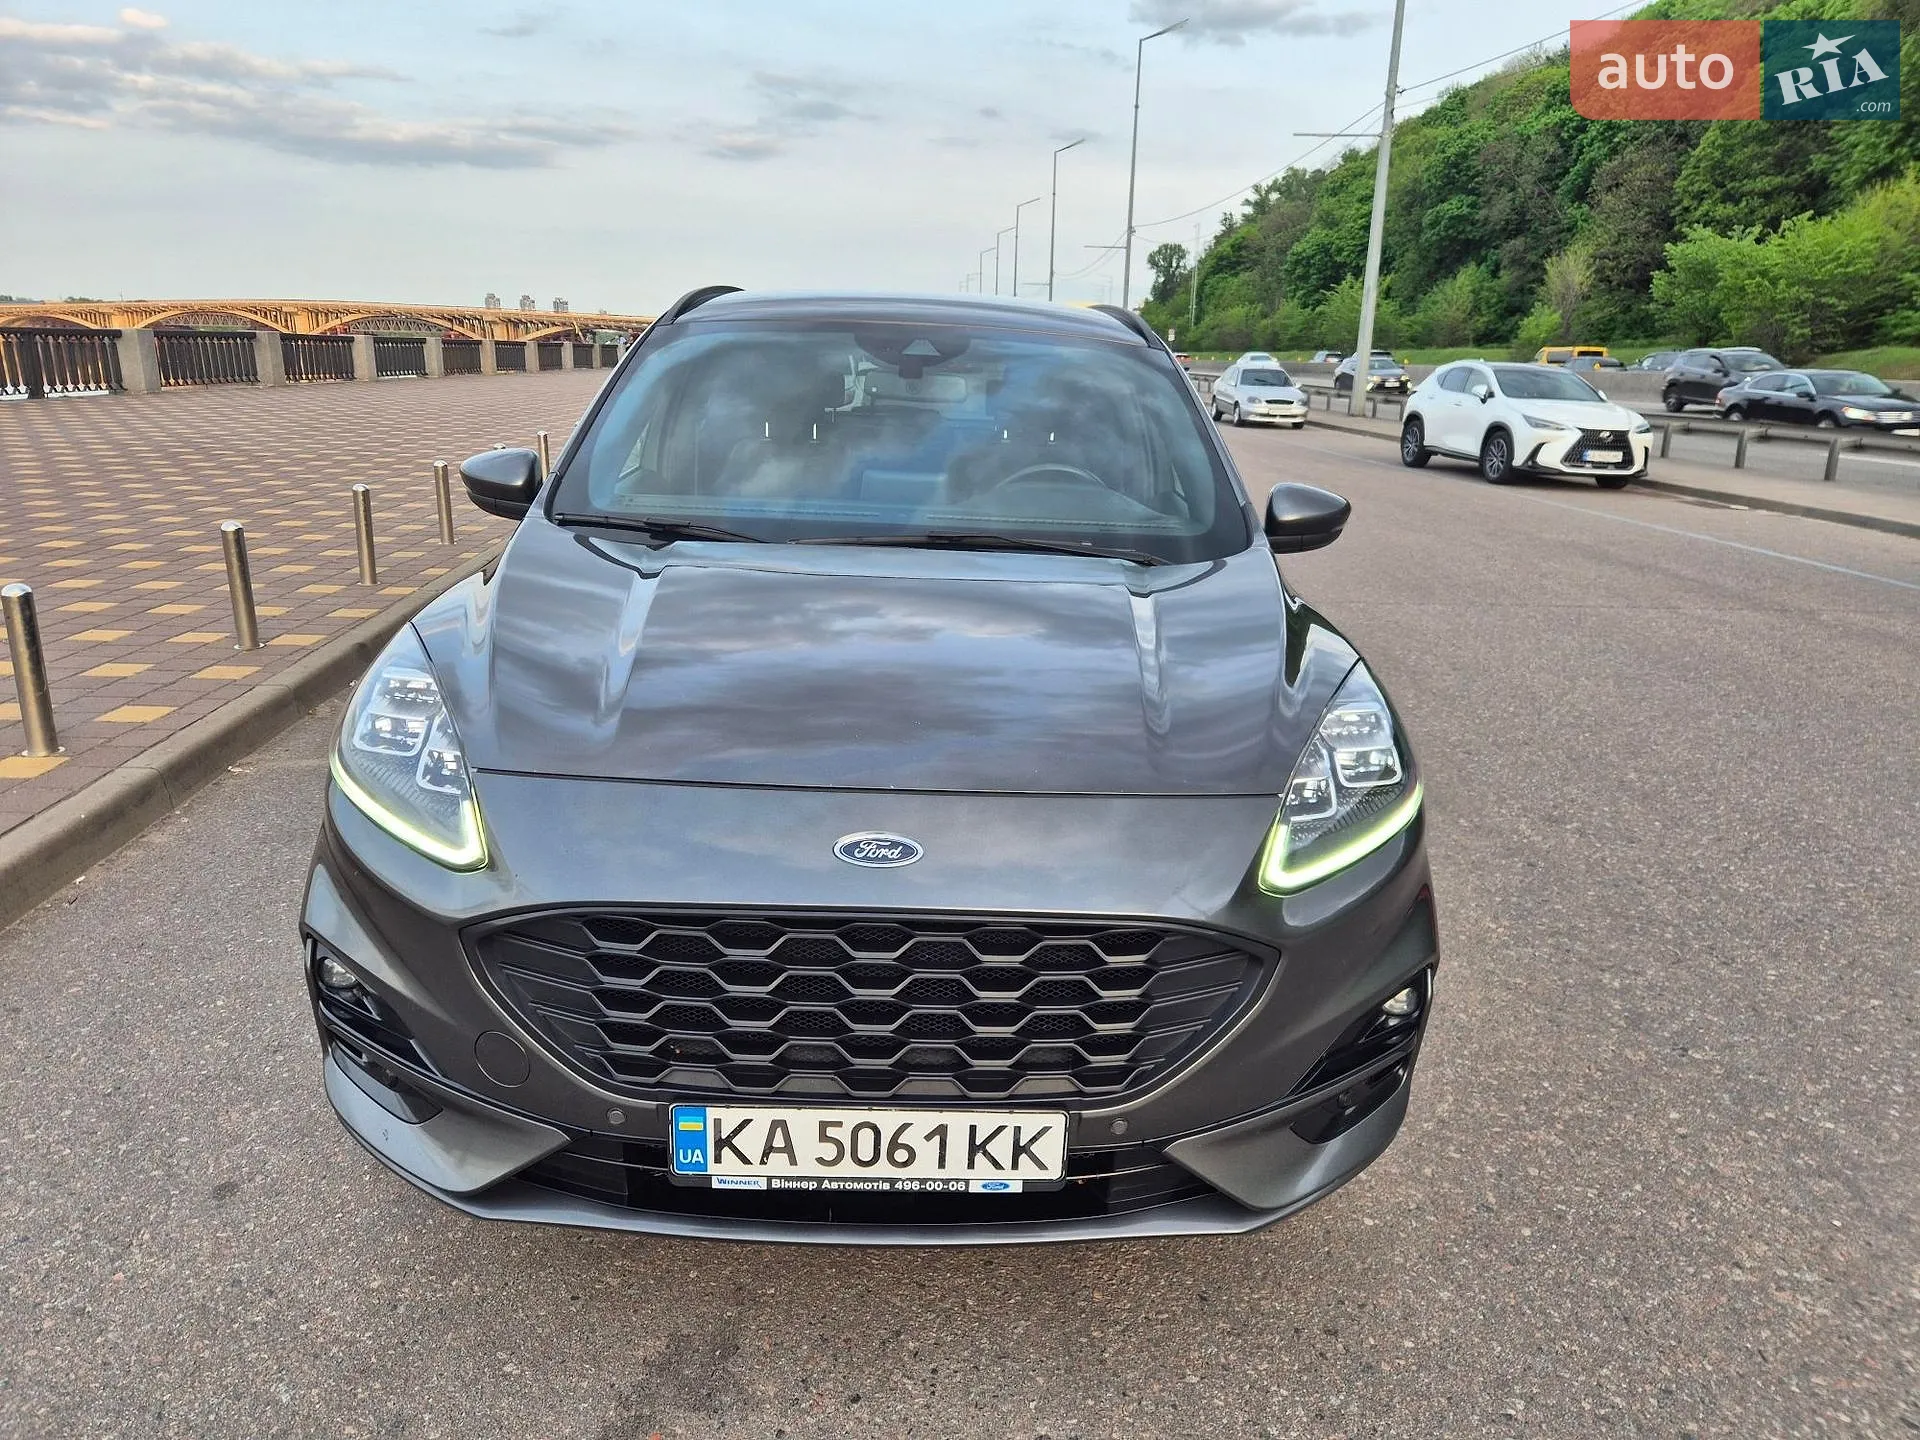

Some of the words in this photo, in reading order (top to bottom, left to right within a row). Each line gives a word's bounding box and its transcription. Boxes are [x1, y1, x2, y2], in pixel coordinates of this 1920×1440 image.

[854, 840, 903, 859] Ford
[713, 1117, 798, 1167] KA
[815, 1120, 948, 1169] 5061
[967, 1124, 1053, 1171] KK
[679, 1148, 704, 1164] UA
[717, 1177, 762, 1188] WINNER
[771, 1178, 818, 1191] Віннер
[821, 1179, 890, 1190] Автомотів
[895, 1180, 966, 1191] 496-00-06
